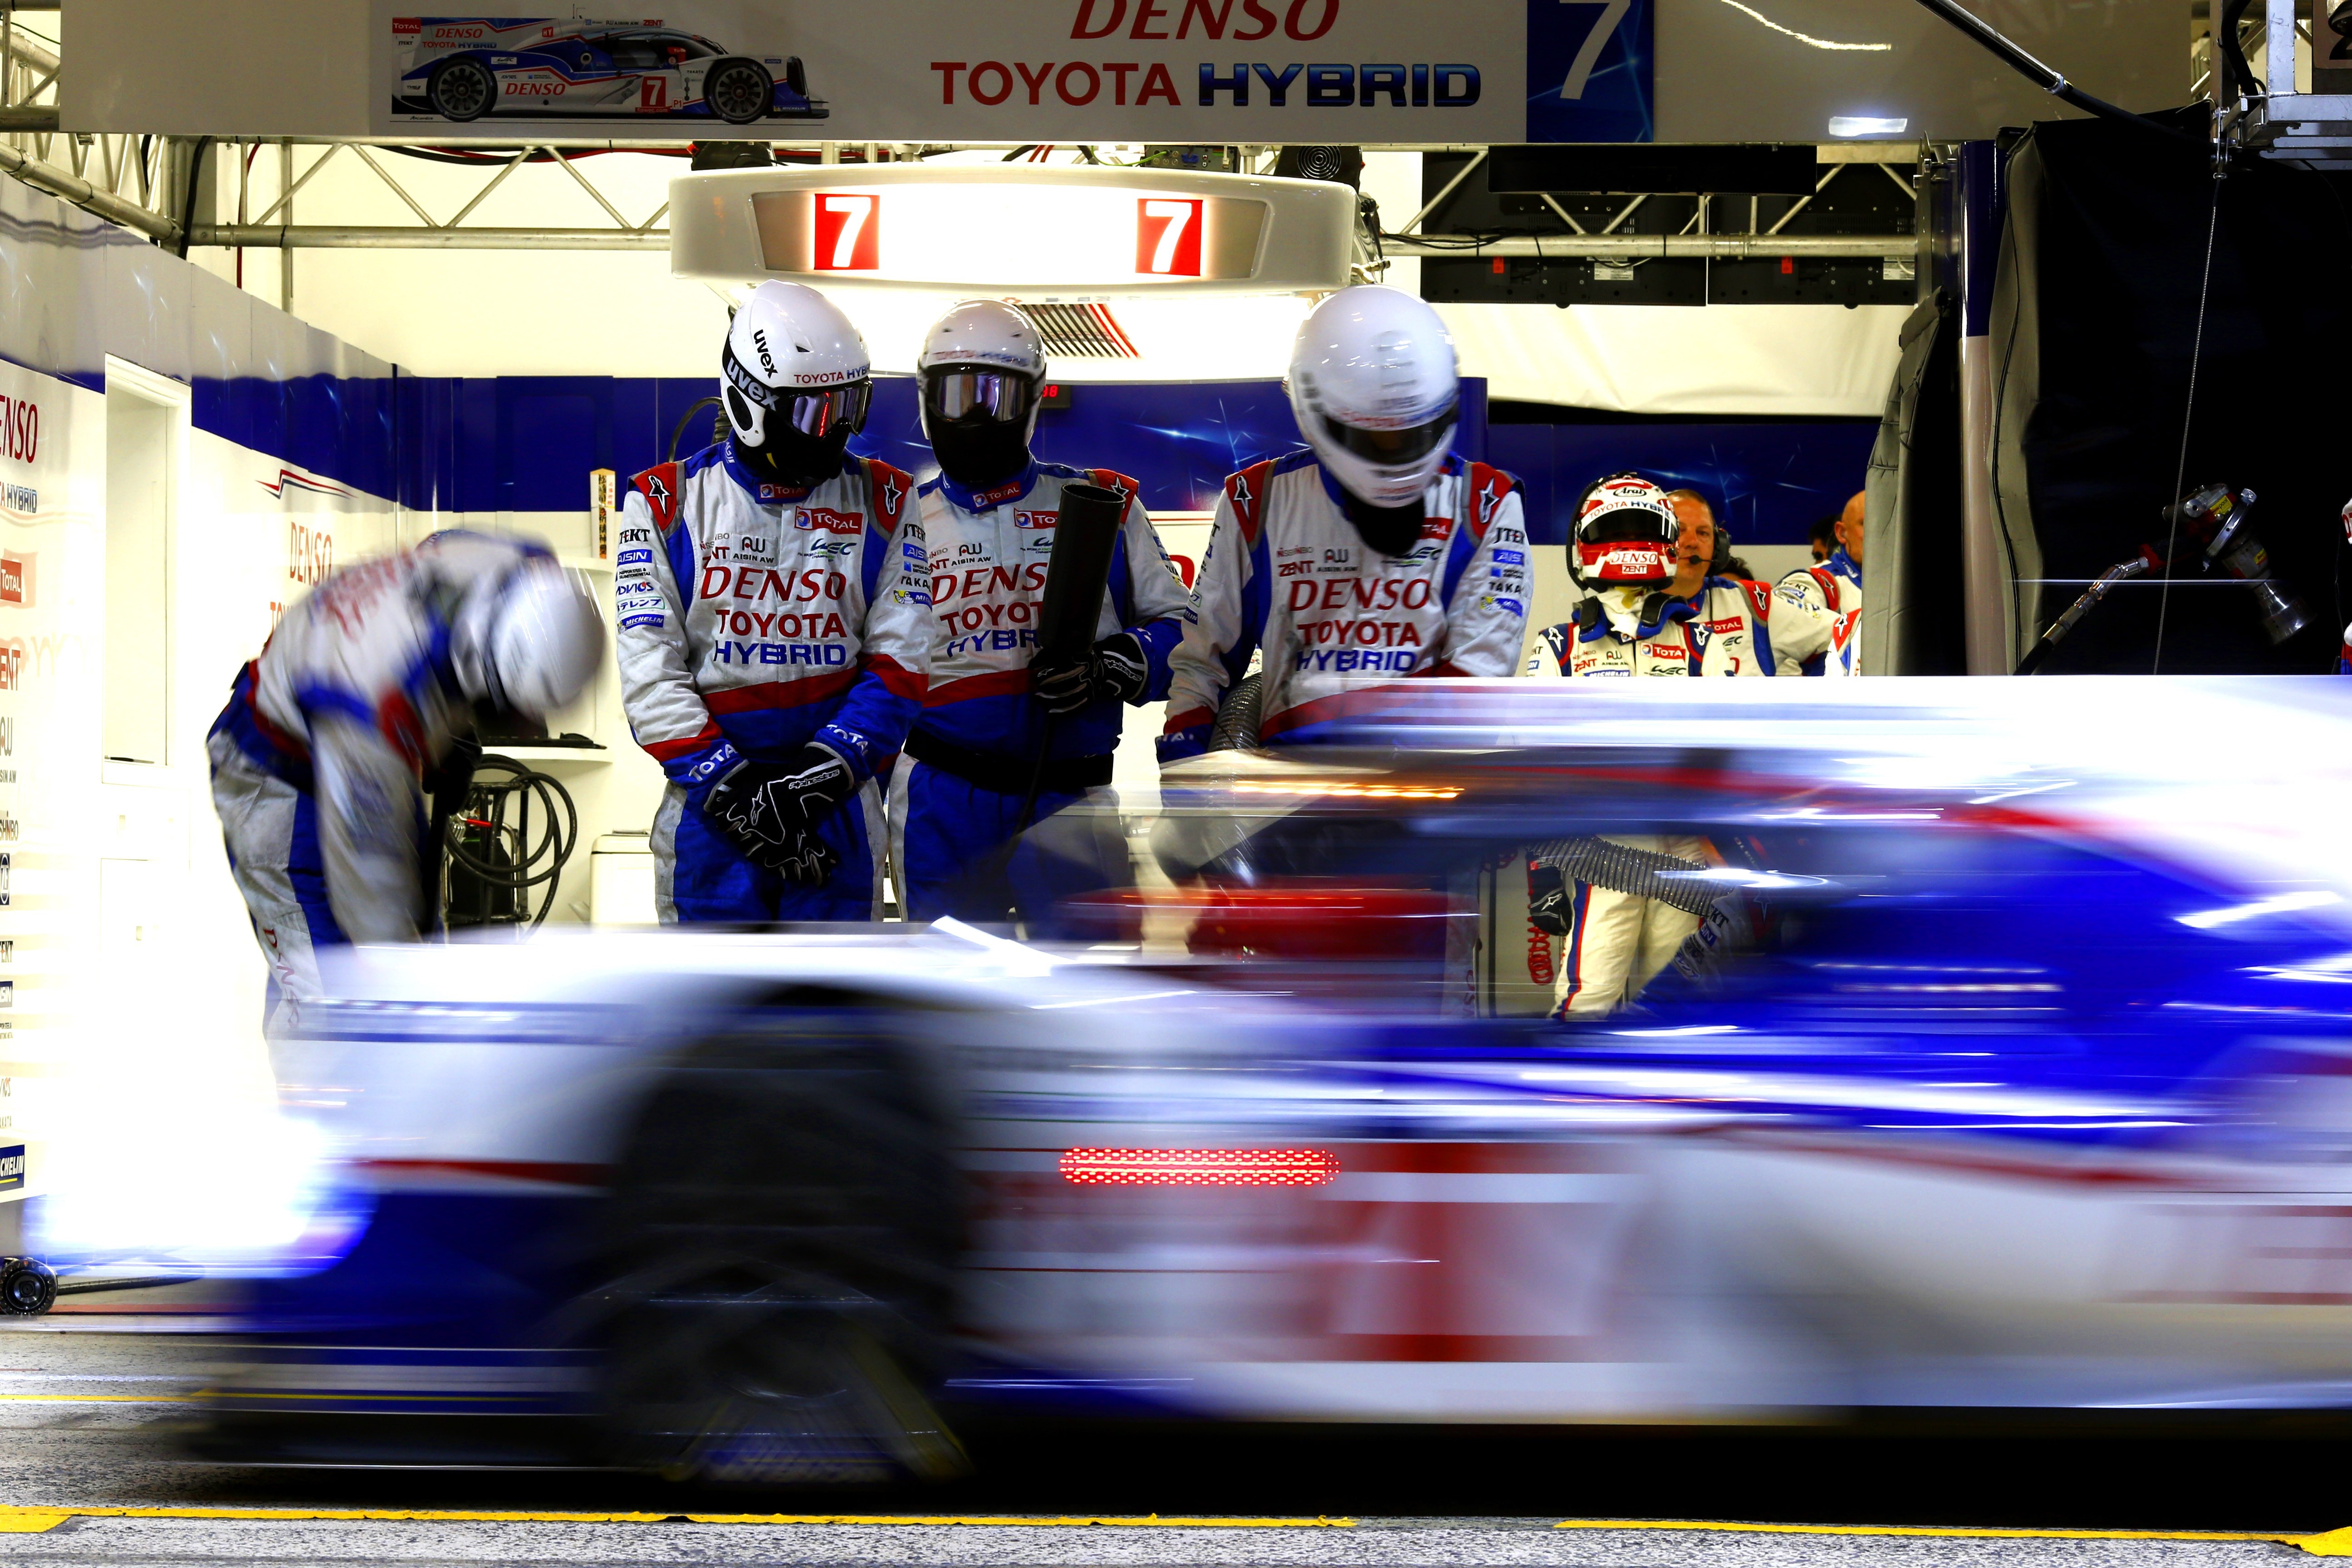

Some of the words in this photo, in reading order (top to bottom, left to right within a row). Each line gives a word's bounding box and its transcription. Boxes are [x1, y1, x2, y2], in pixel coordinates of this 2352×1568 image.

[436, 29, 483, 38] DENSO
[1559, 0, 1630, 101] 7
[505, 83, 565, 95] DENSO
[647, 80, 662, 105] 7
[931, 62, 1180, 107] TOYOTA
[1198, 63, 1481, 107] HYBRID
[826, 196, 871, 267] 7
[1146, 201, 1192, 272] 7
[754, 329, 778, 378] uvex
[727, 357, 780, 411] uvex
[794, 372, 844, 384] TOYOTA
[7, 483, 37, 513] HYBRID
[987, 486, 1019, 501] TOTAL
[1590, 501, 1627, 518] TOYOTA
[814, 513, 858, 529] TOTAL
[290, 522, 332, 587] DENSO
[811, 538, 857, 555] WEC
[618, 552, 647, 563] AISIN
[951, 558, 975, 566] AISIN
[1611, 552, 1657, 562] DENSO
[1279, 561, 1314, 577] ZENT
[1623, 565, 1646, 573] ZENT
[1, 568, 20, 593] TOTAL
[700, 567, 846, 602] DENSO
[1289, 578, 1431, 611] DENSO
[626, 616, 663, 626] MICHELIN
[715, 610, 847, 638] TOYOTA
[1297, 620, 1421, 647] TOYOTA
[714, 640, 846, 665] HYBRID
[1296, 651, 1416, 671] HYBRID
[1574, 659, 1597, 672] ZENT
[9, 770, 16, 784] AW
[789, 769, 840, 789] alpinestars
